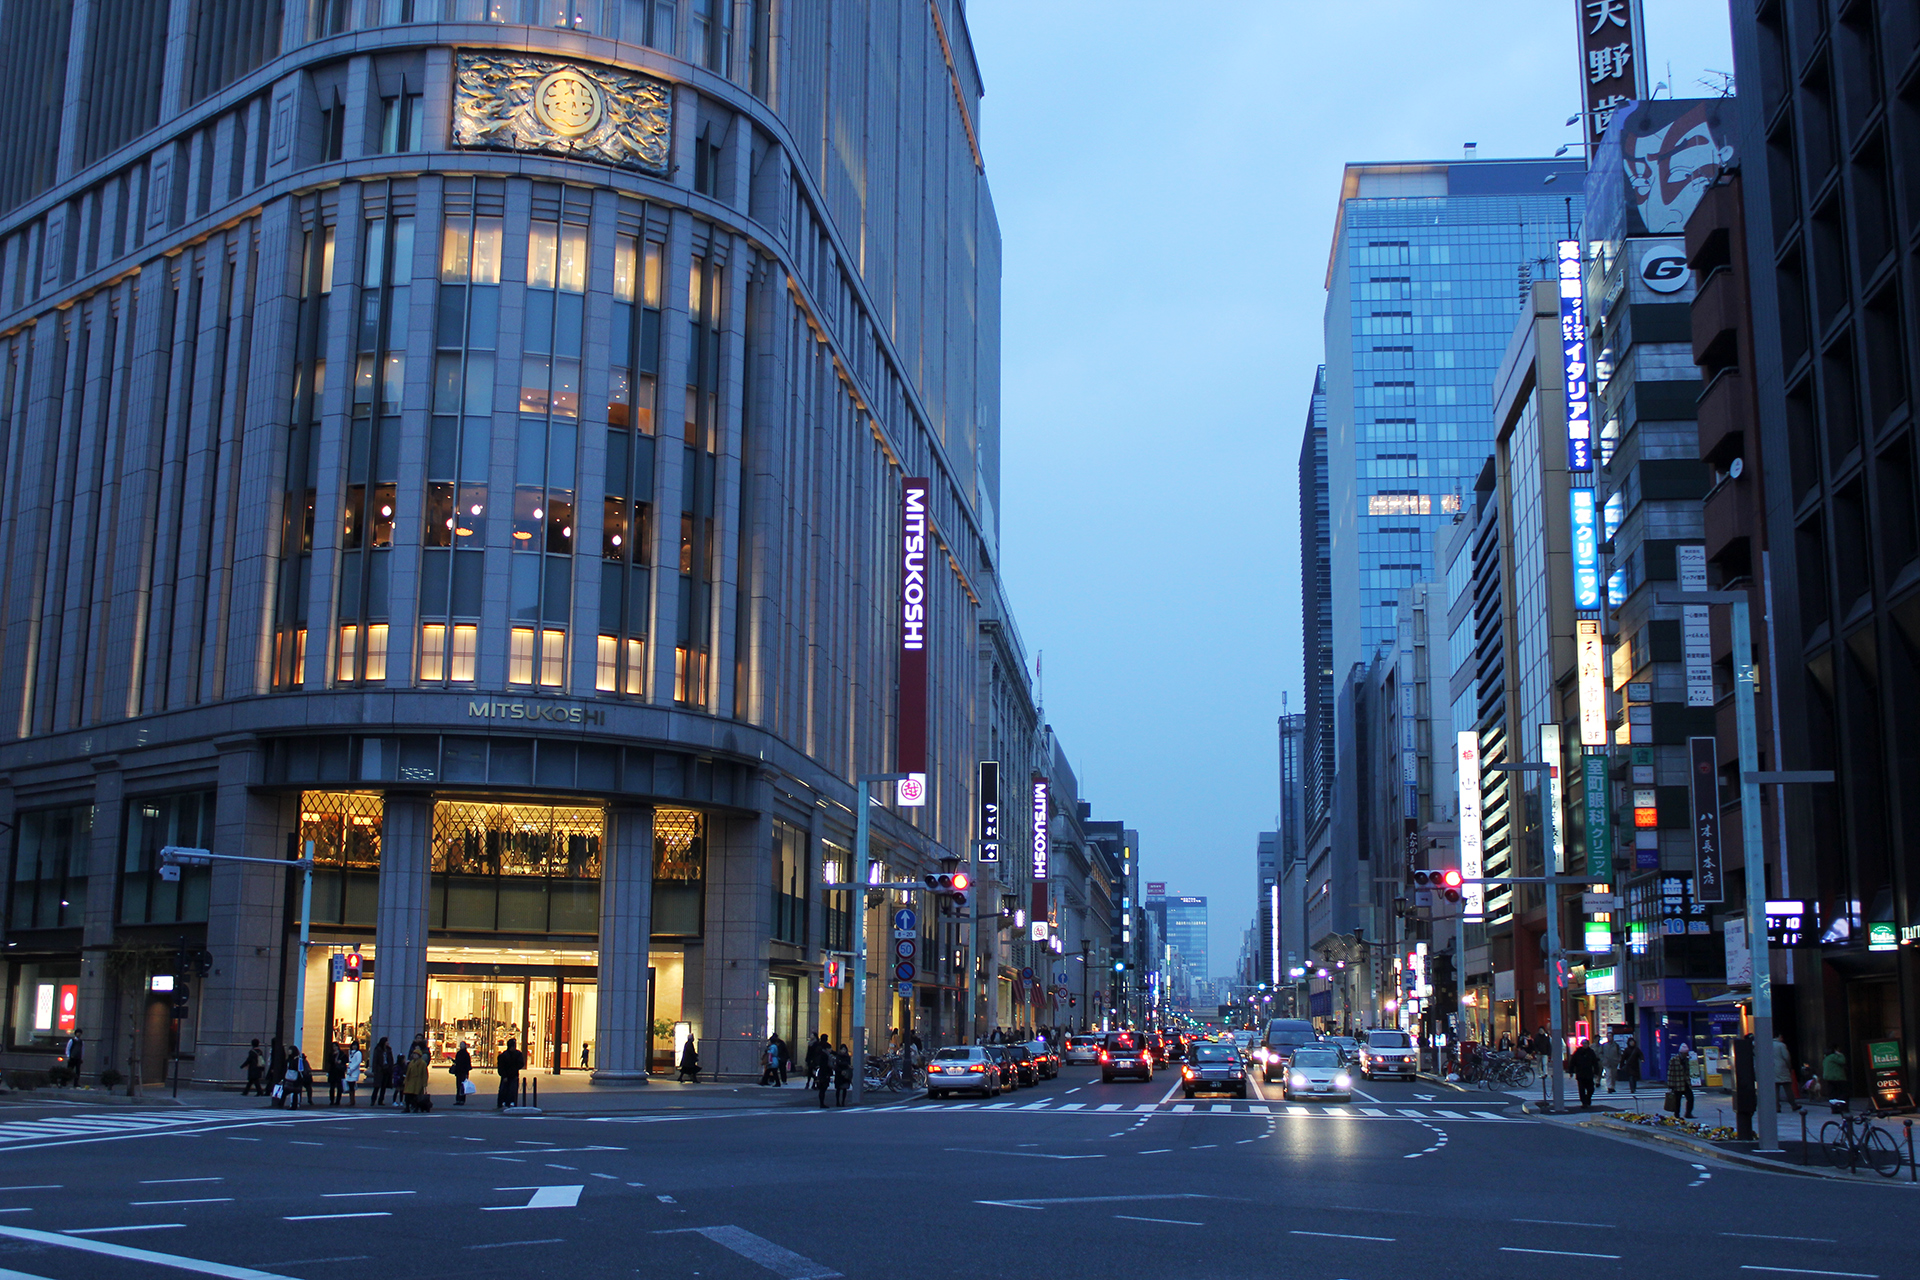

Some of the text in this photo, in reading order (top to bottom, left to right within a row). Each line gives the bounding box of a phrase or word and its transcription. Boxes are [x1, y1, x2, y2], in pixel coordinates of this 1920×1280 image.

[904, 488, 925, 649] MITSUKOSHI
[468, 701, 605, 726] MITSUKOSHI
[1587, 732, 1600, 740] 3F
[1586, 759, 1606, 876] 室町眼科クリニック
[1033, 783, 1046, 878] MITSUKOSHI
[1690, 904, 1705, 914] 2F
[1664, 918, 1684, 933] 10
[1870, 932, 1896, 941] Italia
[900, 944, 911, 954] 50
[1874, 1054, 1899, 1063] Italia
